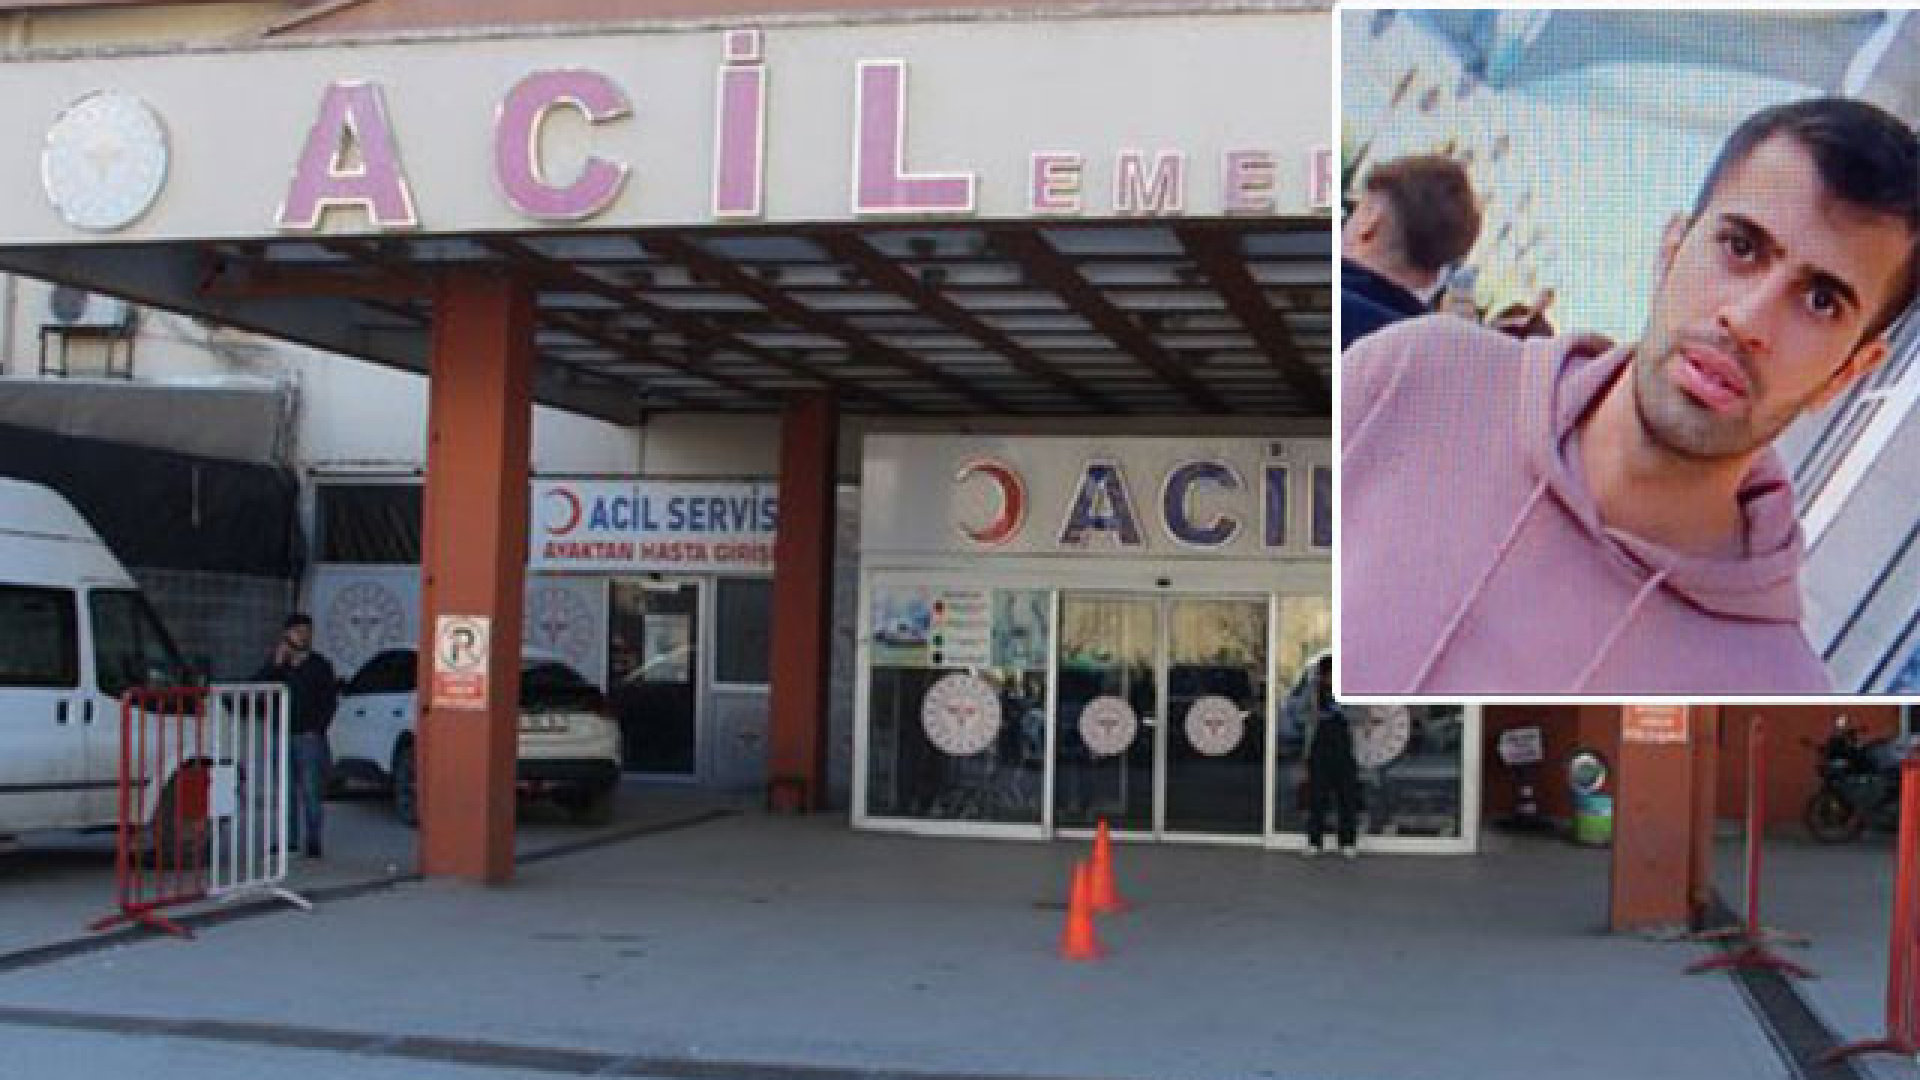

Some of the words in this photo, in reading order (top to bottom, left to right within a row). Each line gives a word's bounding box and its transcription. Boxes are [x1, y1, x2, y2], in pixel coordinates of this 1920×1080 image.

[276, 29, 976, 231] ACİL
[587, 484, 660, 532] ACİL
[666, 484, 778, 532] SERVİS
